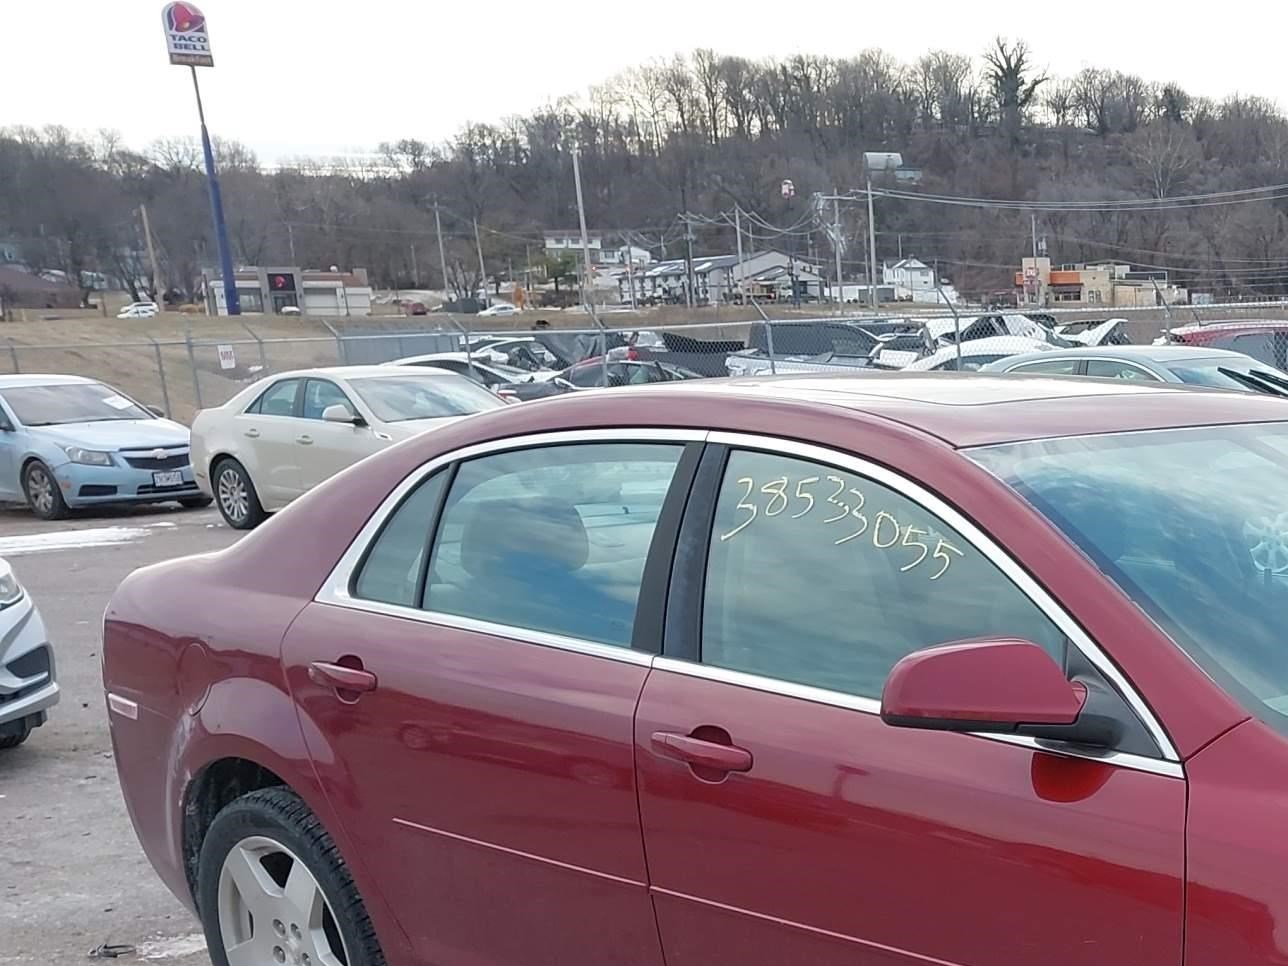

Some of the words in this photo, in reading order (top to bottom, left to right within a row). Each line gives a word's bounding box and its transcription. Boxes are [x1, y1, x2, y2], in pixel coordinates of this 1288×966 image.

[169, 34, 207, 43] TACO
[173, 43, 209, 51] BELL
[720, 475, 965, 580] 38533055
